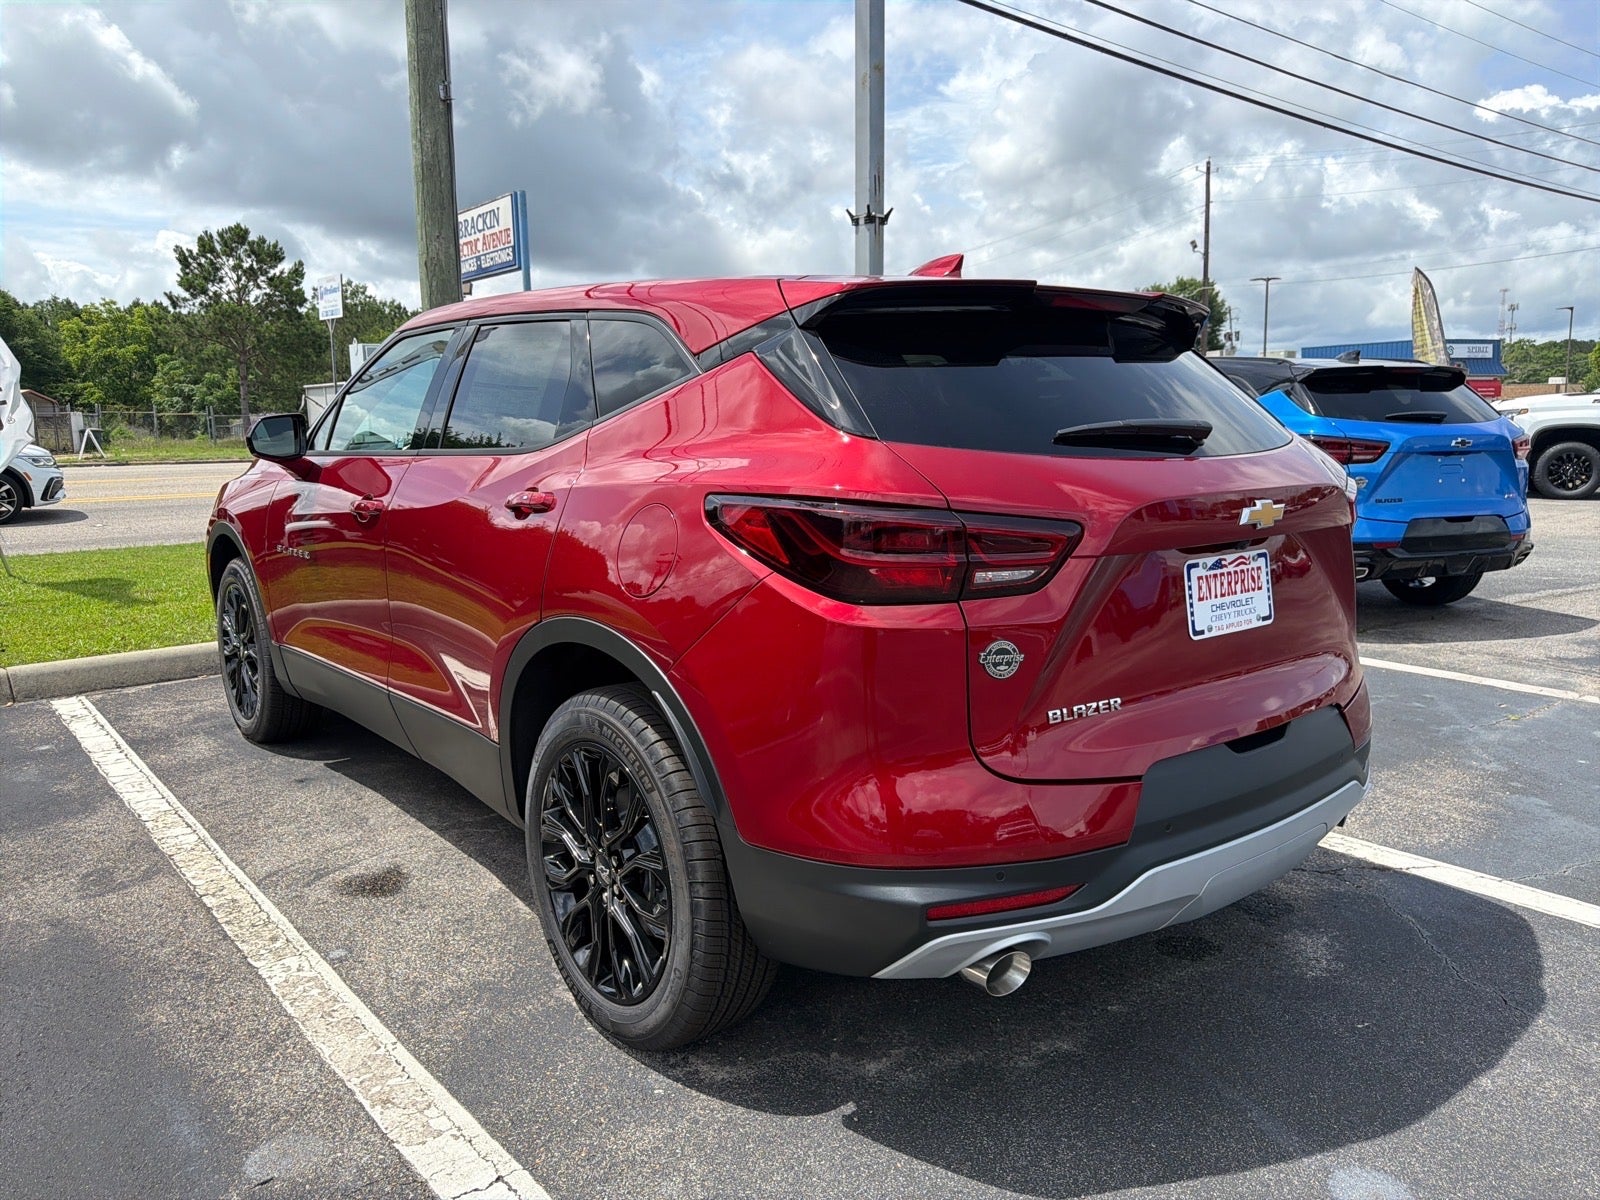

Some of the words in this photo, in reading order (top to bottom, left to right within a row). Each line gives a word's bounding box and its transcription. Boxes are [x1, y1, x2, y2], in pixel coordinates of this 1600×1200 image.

[458, 207, 500, 239] BRACKIN
[482, 228, 511, 252] AVENUE
[1197, 566, 1263, 602] ENTERPRISE
[1210, 597, 1255, 613] CHEVROLET
[1210, 612, 1233, 622] CHEVY
[1233, 607, 1257, 617] TRUCKS
[1214, 624, 1225, 633] TAG
[1225, 620, 1243, 630] APPLIED
[1244, 618, 1253, 627] FOR
[979, 652, 1024, 665] Enterprise
[1047, 697, 1122, 725] BLAZER
[602, 726, 653, 792] MICHELIN
